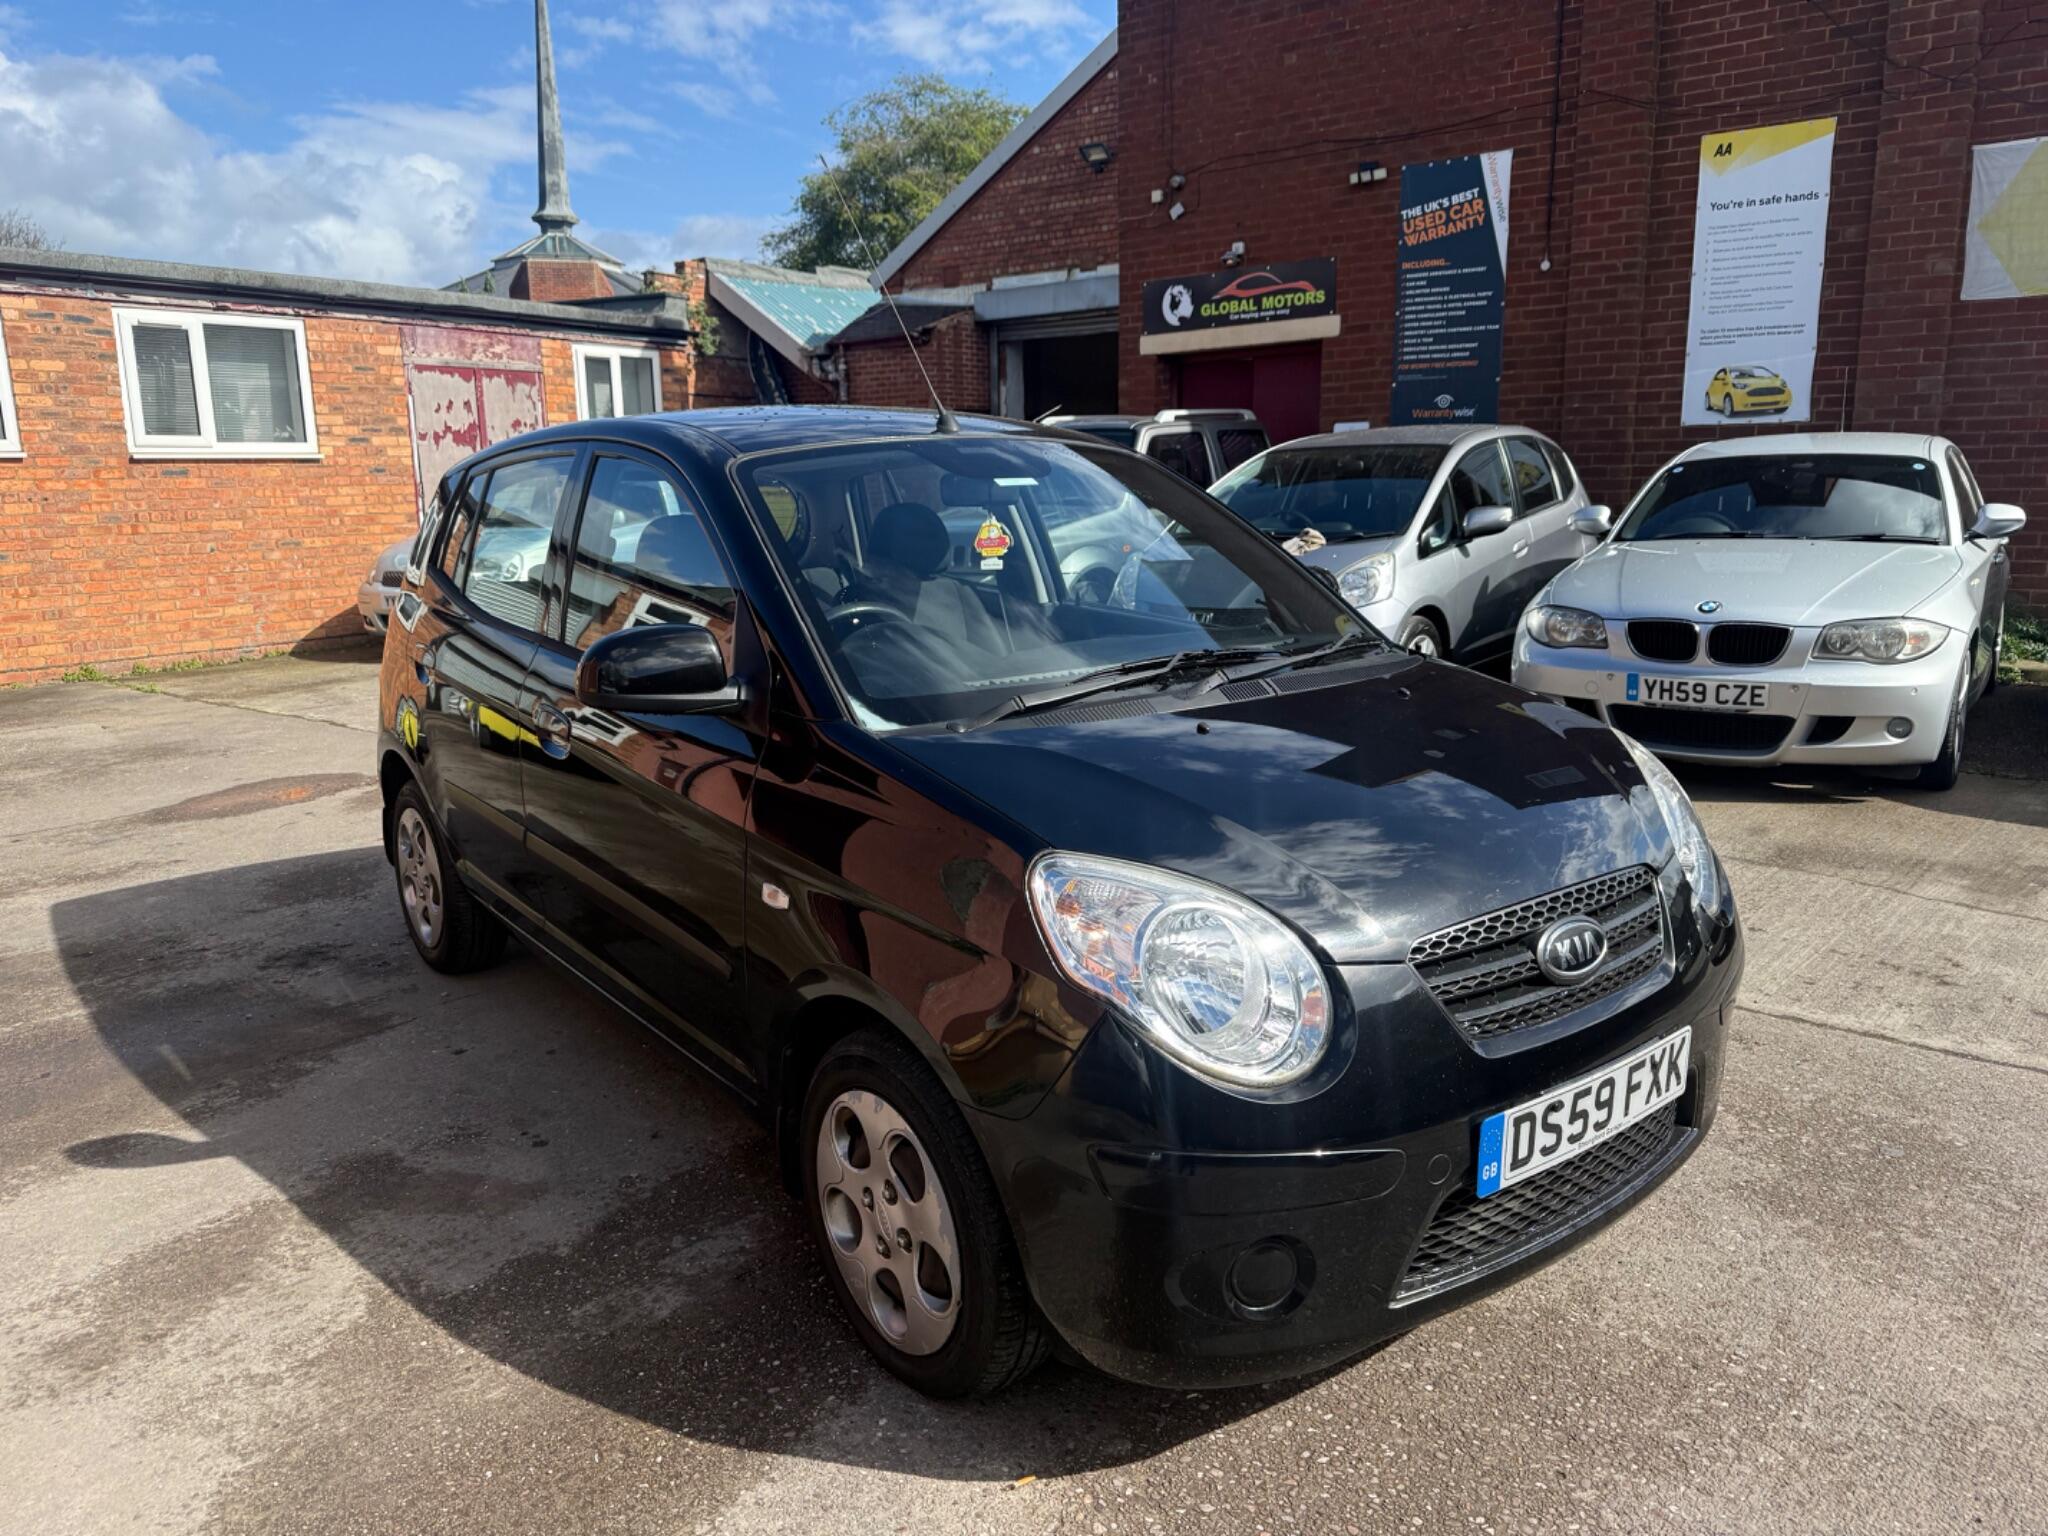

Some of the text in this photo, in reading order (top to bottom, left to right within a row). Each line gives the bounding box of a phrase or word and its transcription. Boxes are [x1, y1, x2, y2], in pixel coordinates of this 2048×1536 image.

[1714, 142, 1732, 157] AA
[1401, 187, 1480, 220] THE UK'S BEST
[1710, 190, 1820, 211] You're in safe hands
[1403, 198, 1485, 234] USED CAR
[1404, 213, 1485, 247] WARRANTY
[1201, 290, 1326, 316] GLOBAL MOTORS
[1644, 678, 1766, 706] YH59 CZE
[1555, 931, 1600, 970] KIA
[1510, 1036, 1687, 1172] DS59 FXK
[1482, 1162, 1498, 1180] GB
